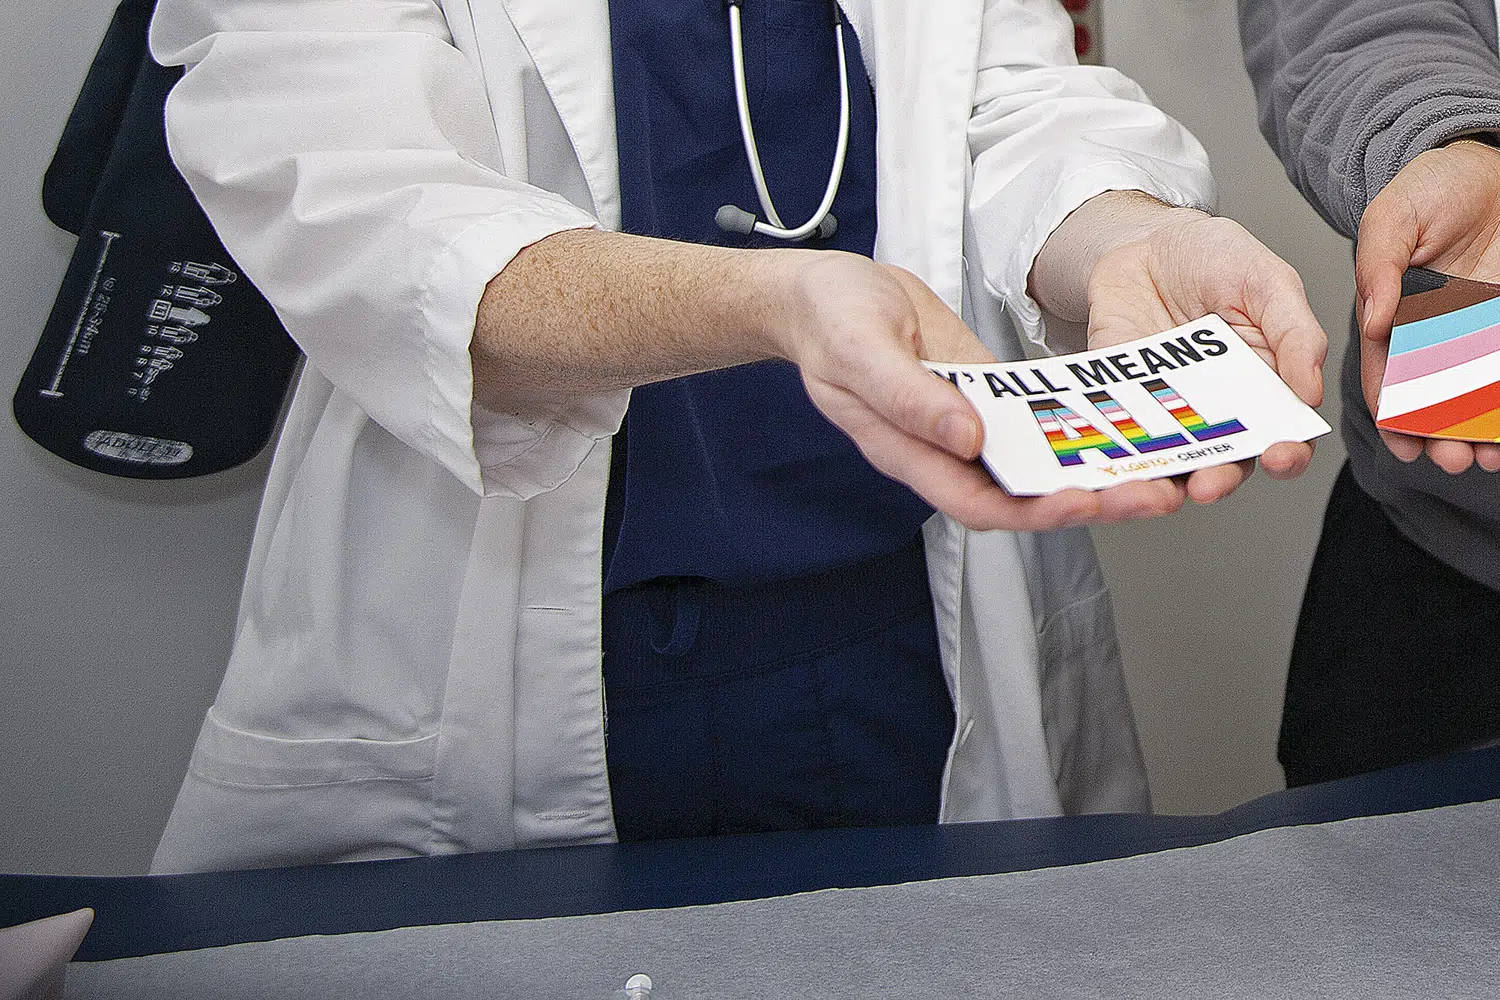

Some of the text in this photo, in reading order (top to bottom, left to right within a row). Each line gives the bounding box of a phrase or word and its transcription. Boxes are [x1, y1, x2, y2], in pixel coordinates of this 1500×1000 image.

[147, 324, 160, 336] 10
[931, 328, 1229, 398] Y'ALL MEANS
[1027, 378, 1249, 467] ALL
[1177, 442, 1236, 462] CENTER
